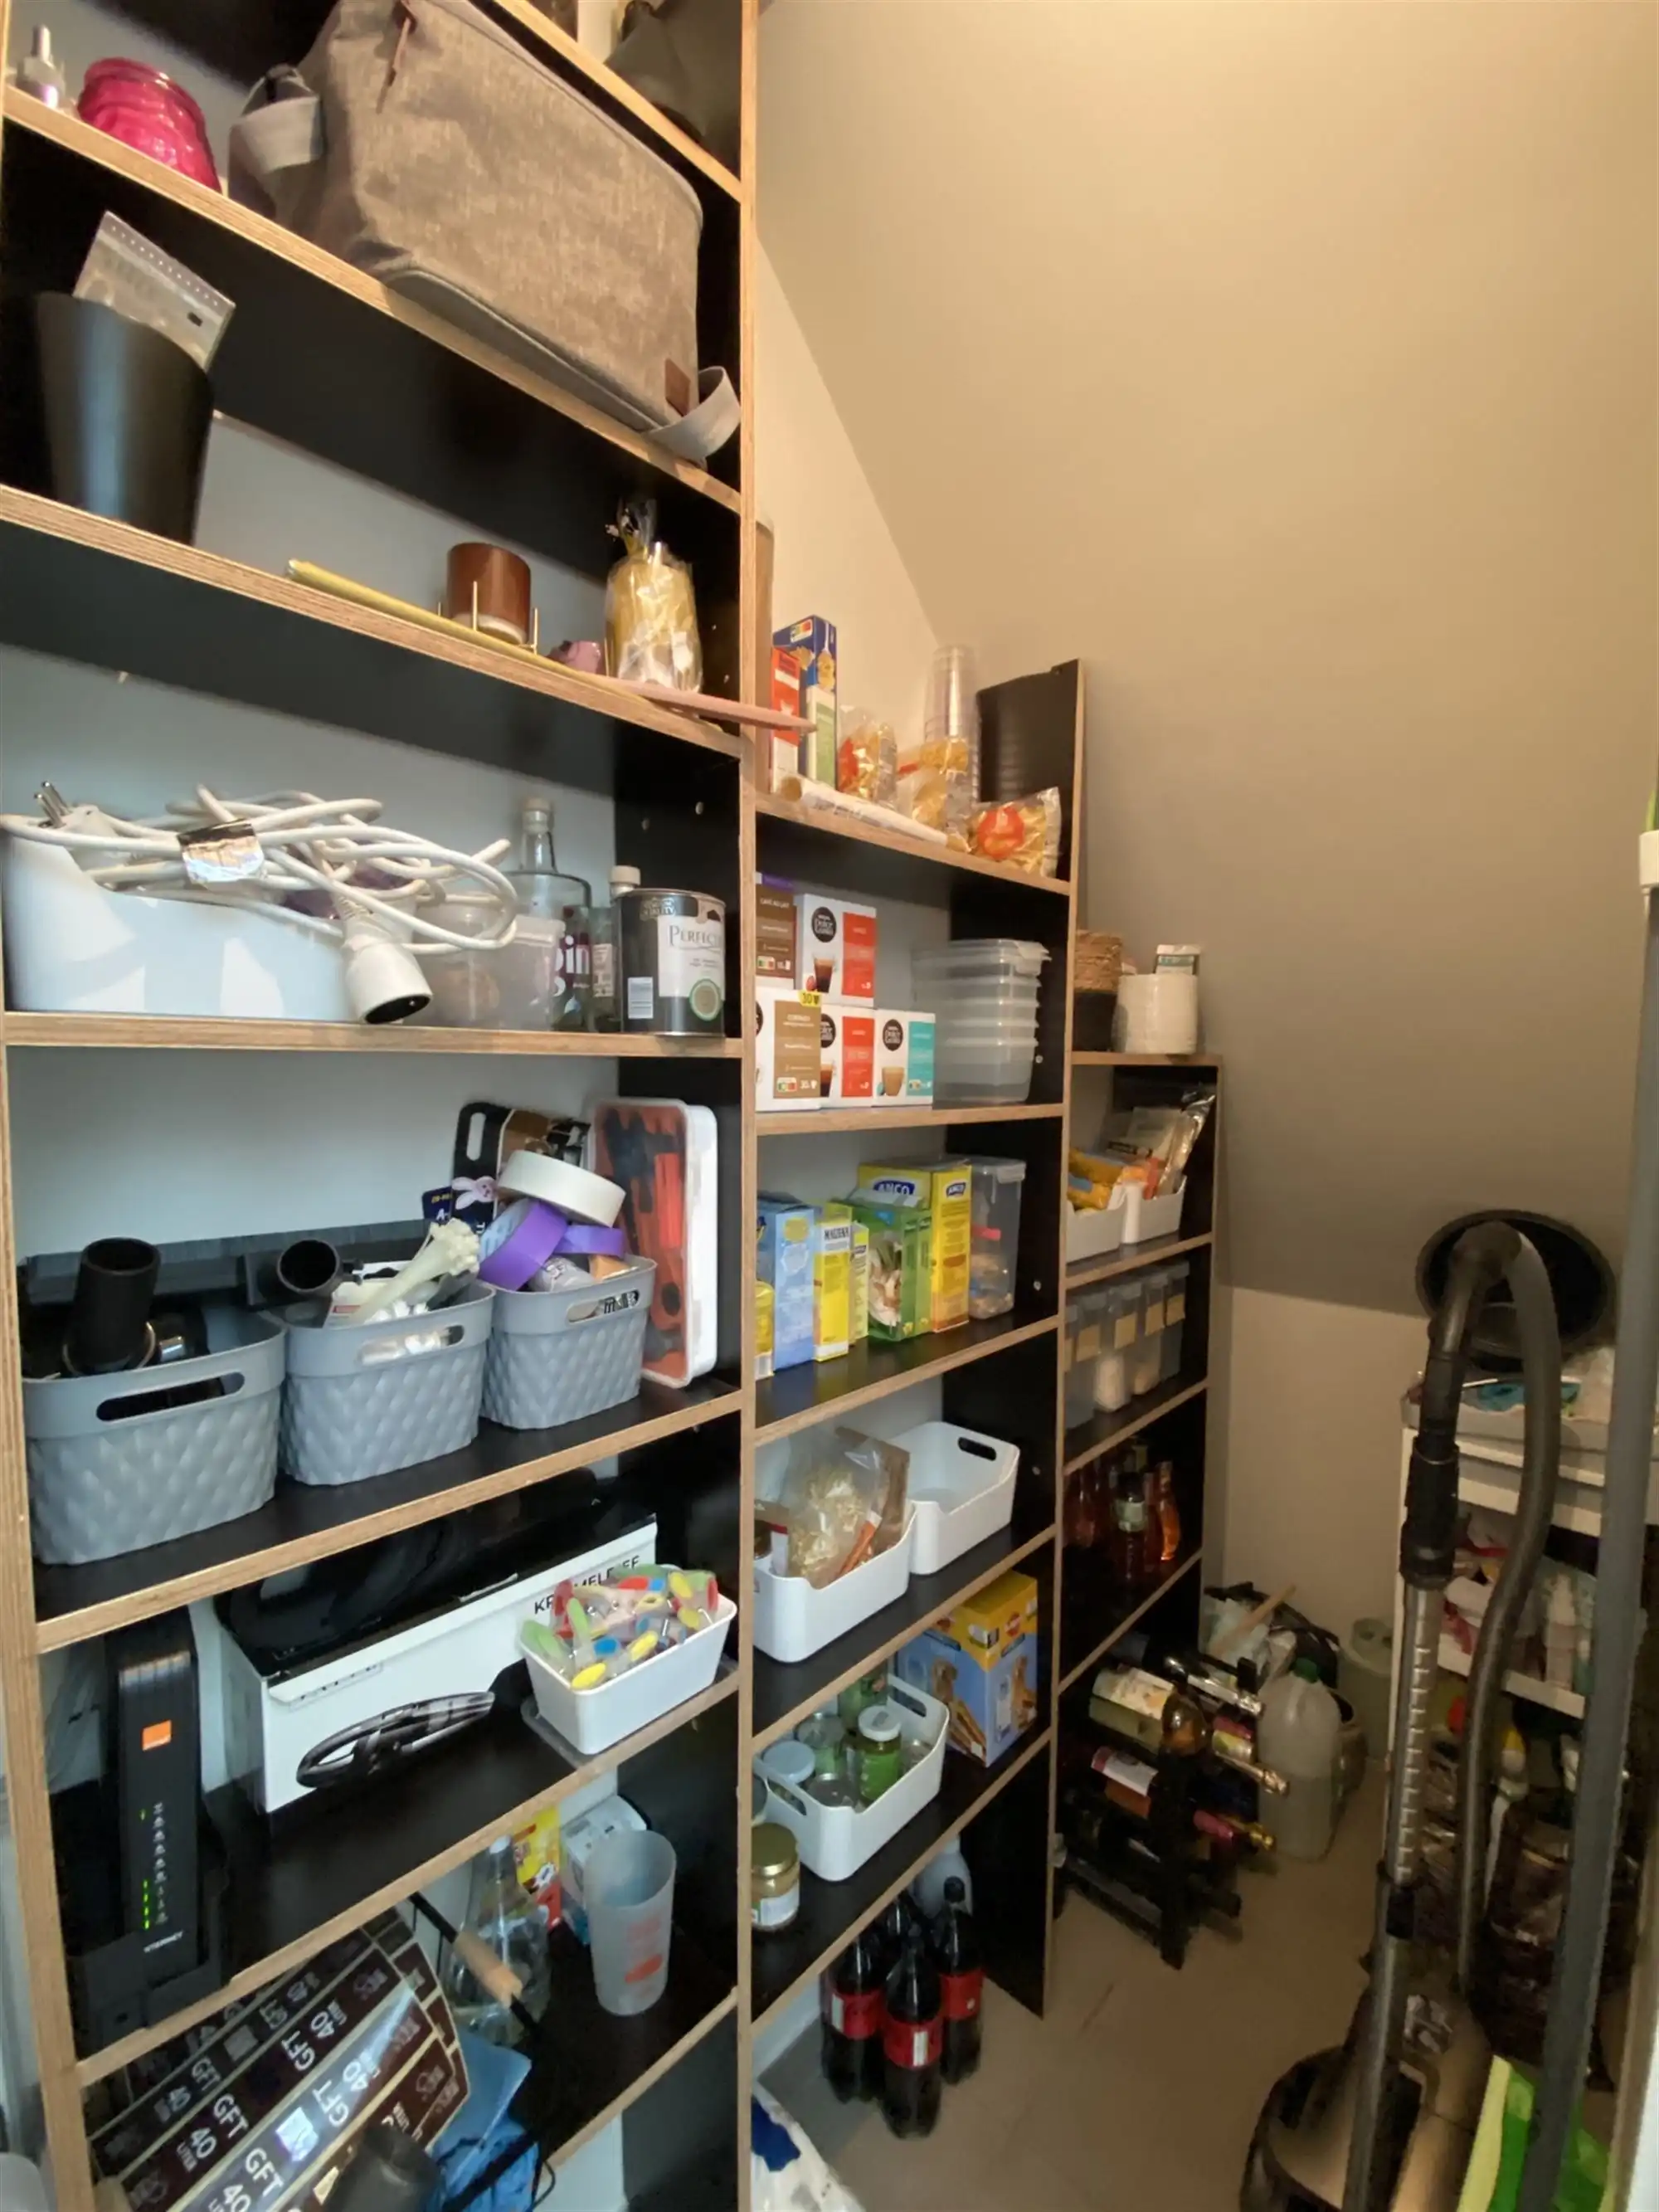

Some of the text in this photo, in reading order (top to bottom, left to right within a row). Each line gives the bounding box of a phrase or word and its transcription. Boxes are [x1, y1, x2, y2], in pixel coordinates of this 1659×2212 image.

[281, 2030, 316, 2072] GFT
[212, 2093, 249, 2139] GFT
[312, 2079, 350, 2128] GFT
[190, 2127, 217, 2160] 40
[245, 2146, 285, 2198] GFT
[222, 2183, 251, 2212] 40
